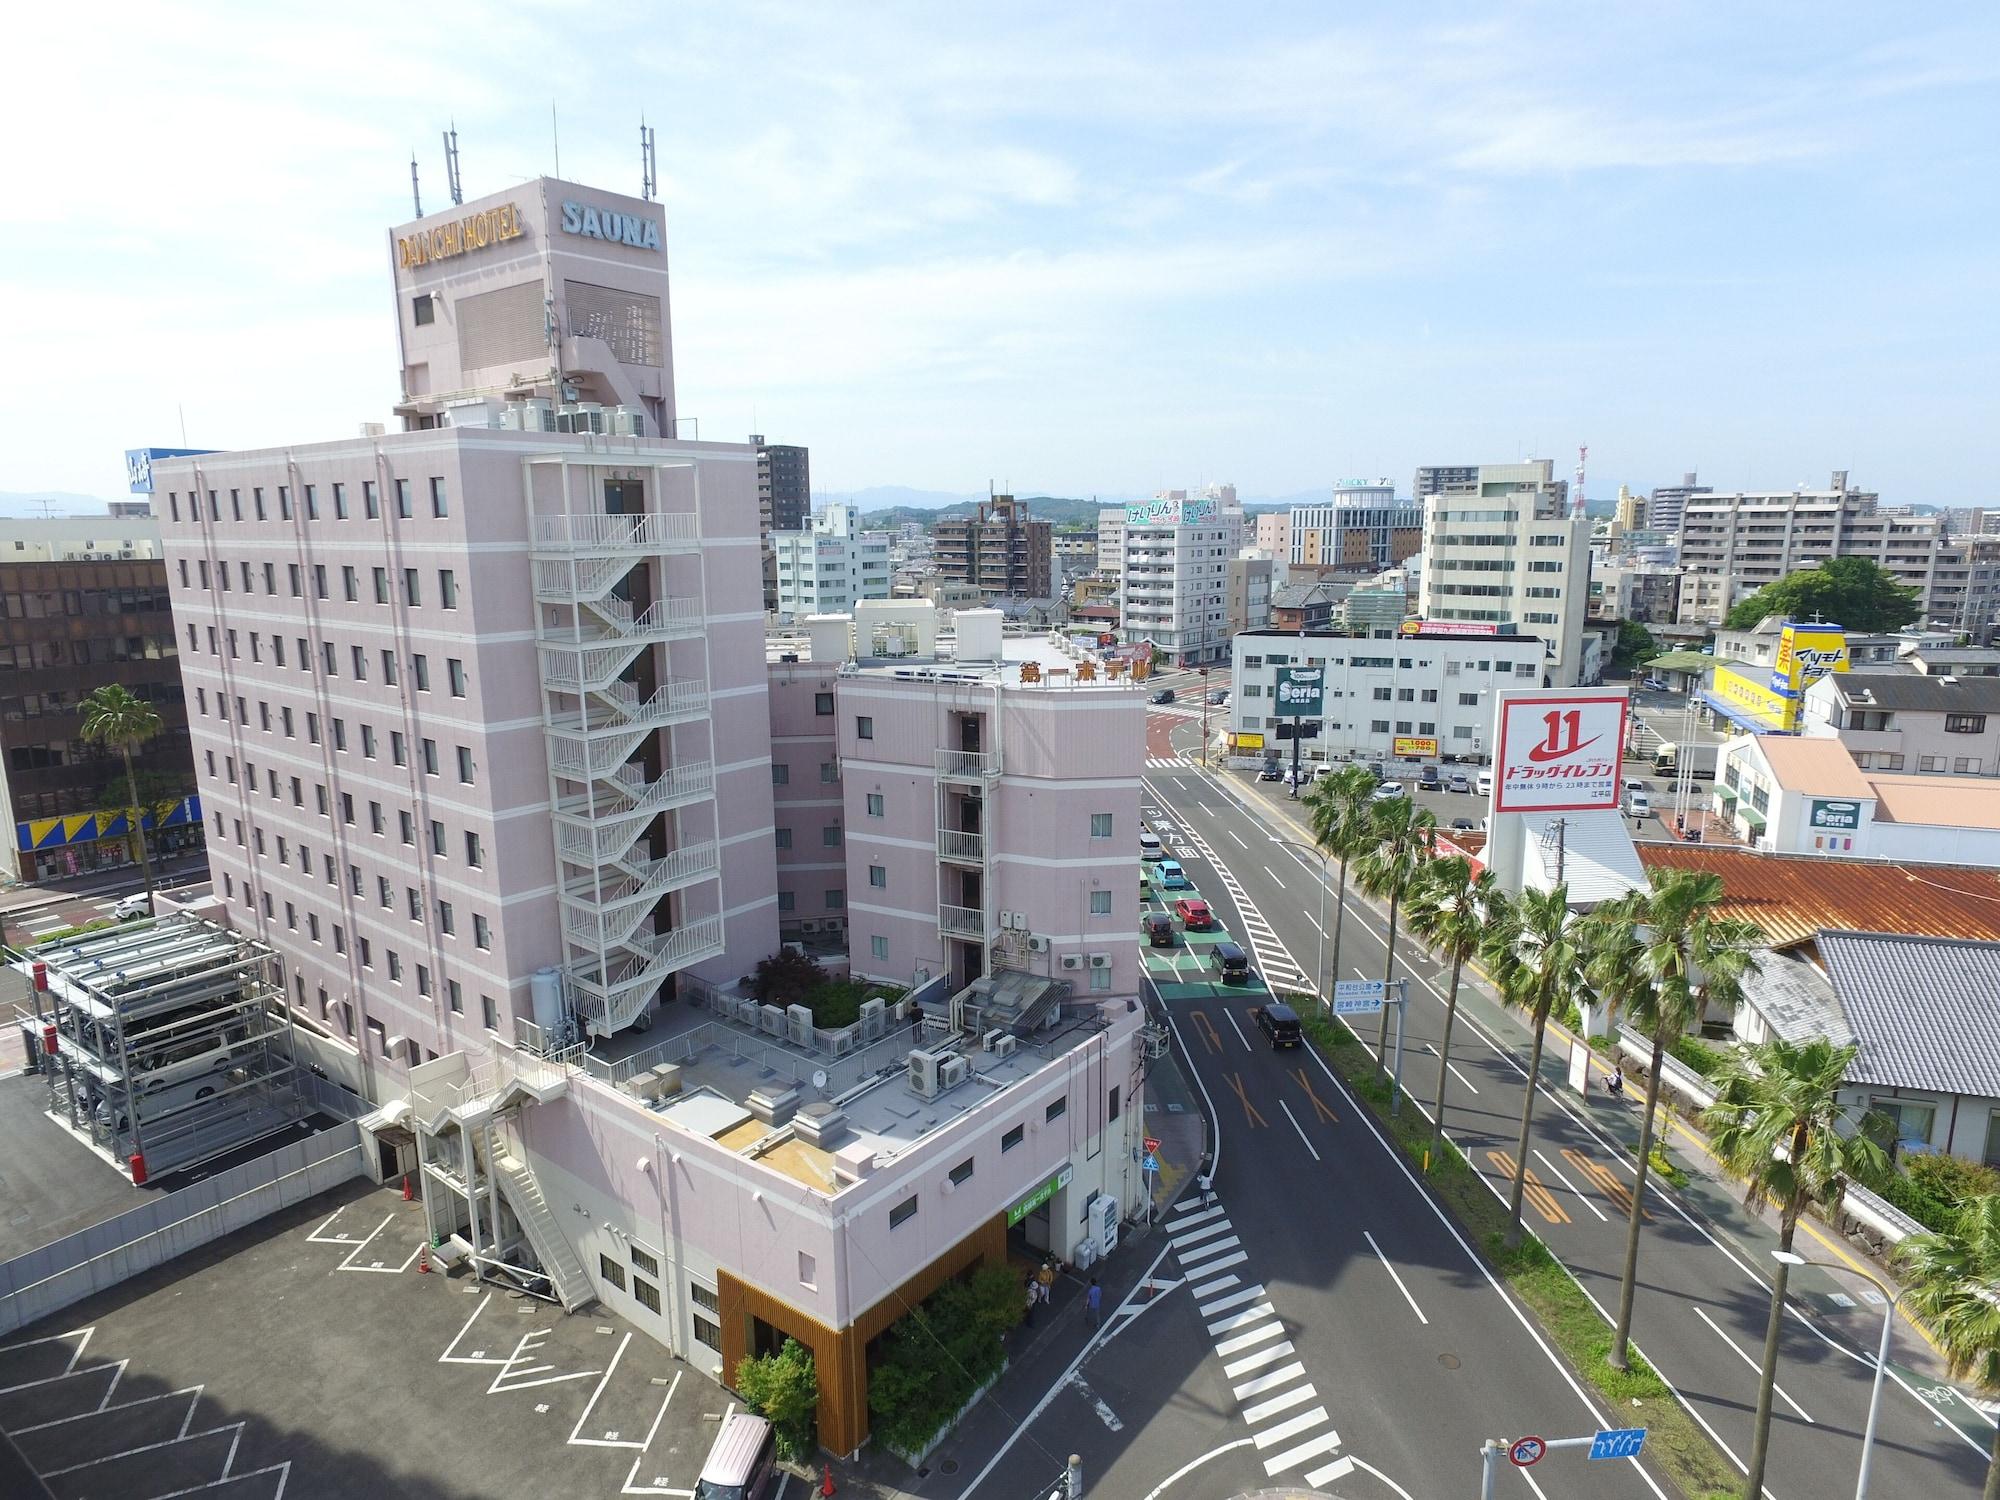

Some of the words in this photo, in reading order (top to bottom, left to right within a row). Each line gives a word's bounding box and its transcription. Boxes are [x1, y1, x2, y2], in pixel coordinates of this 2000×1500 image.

[462, 202, 521, 251] HOTEL
[561, 200, 661, 251] SAUNA
[1127, 501, 1173, 522] けいりん
[1183, 501, 1213, 522] けいりん
[1778, 634, 1793, 671] 薬
[1795, 649, 1844, 665] マツモト
[1020, 660, 1152, 683] 第一ホテル
[1279, 681, 1320, 701] Seria
[1506, 763, 1613, 779] ドラッグイレブン
[1815, 809, 1853, 824] Seria
